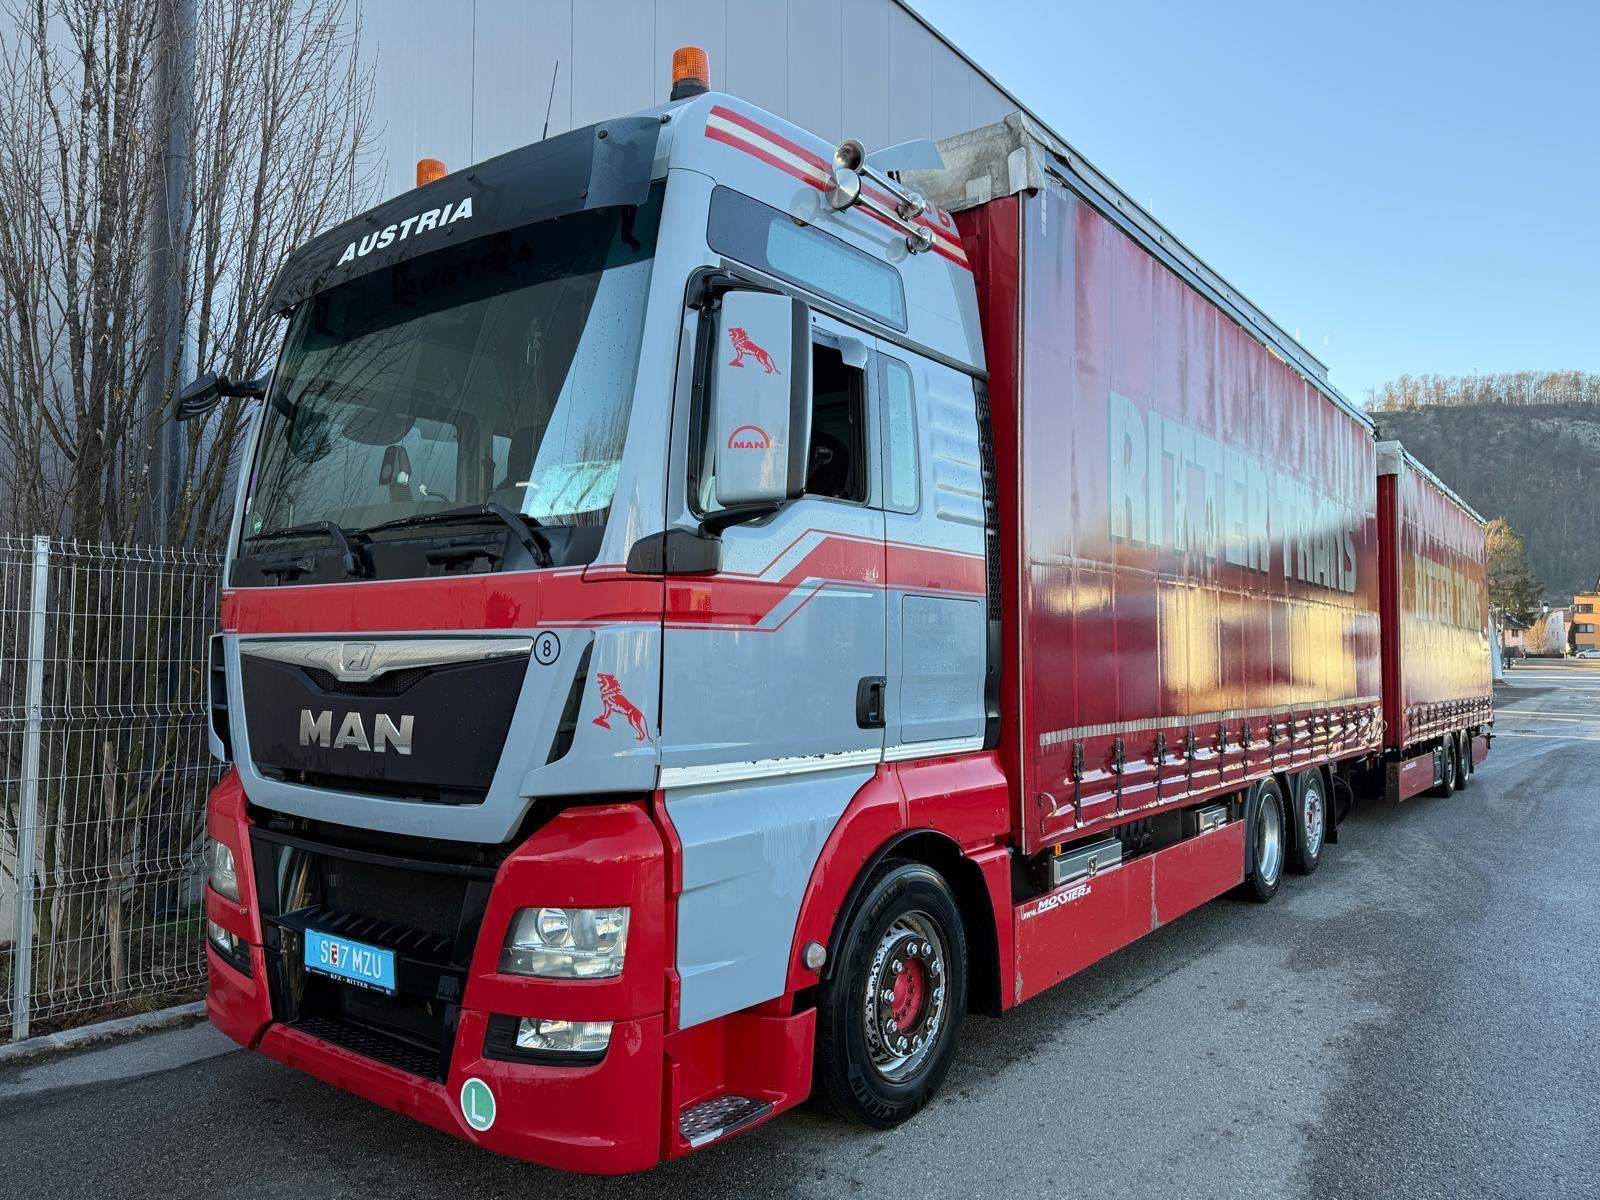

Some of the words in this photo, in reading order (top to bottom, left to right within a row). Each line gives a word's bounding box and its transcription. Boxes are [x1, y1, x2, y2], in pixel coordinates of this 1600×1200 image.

[336, 197, 473, 267] AUSTRIA
[733, 441, 764, 449] MAN
[1109, 390, 1270, 575] RITTER
[1276, 468, 1357, 593] TRANS
[543, 640, 551, 657] 8
[300, 709, 415, 755] MAN
[471, 1088, 486, 1122] L
